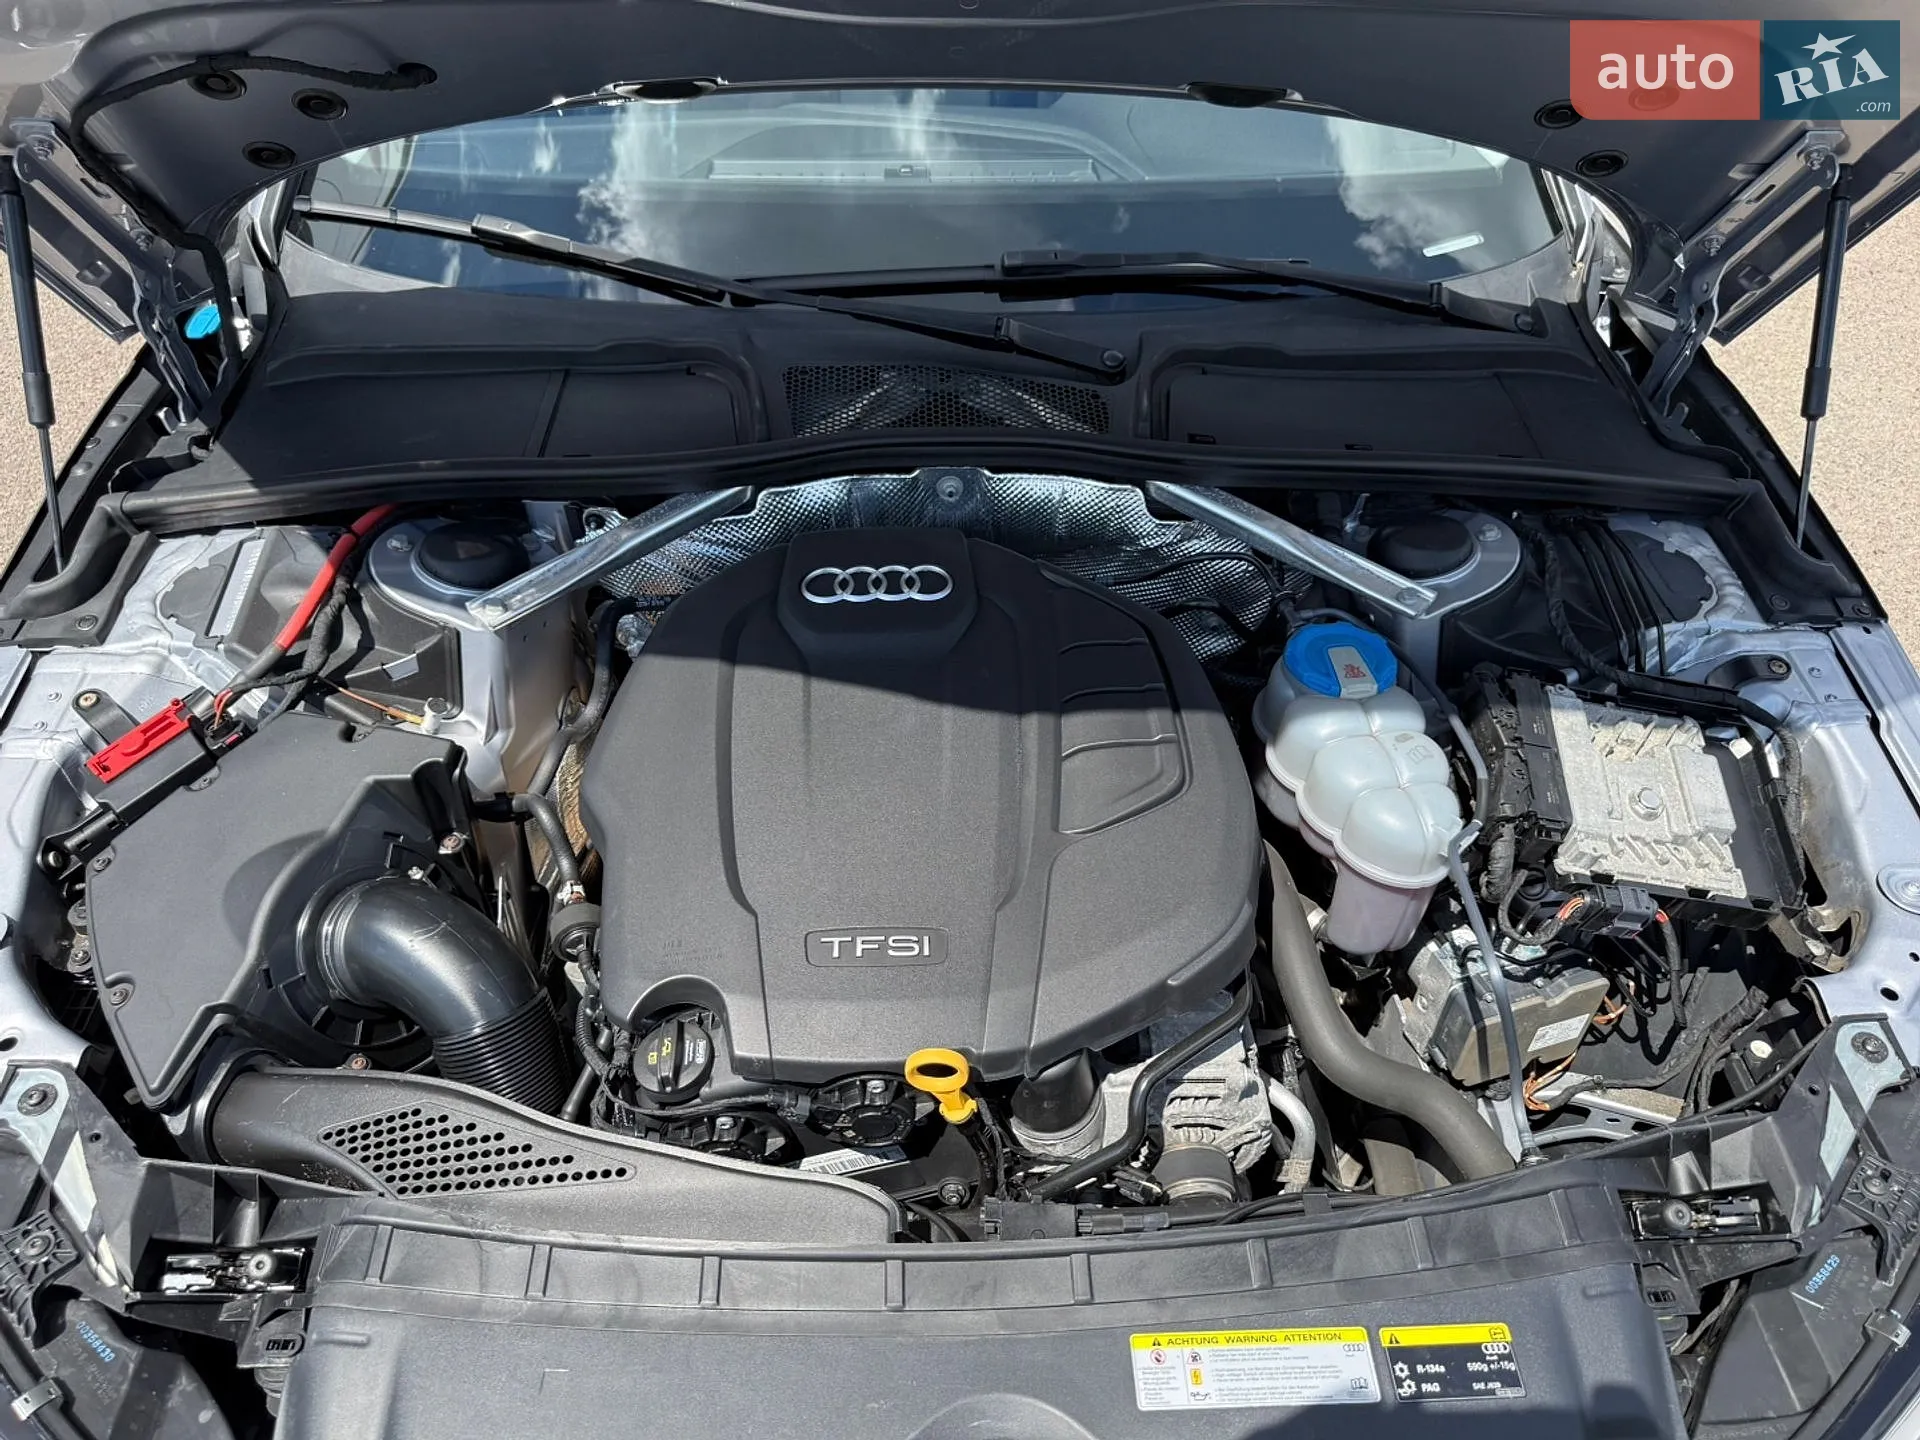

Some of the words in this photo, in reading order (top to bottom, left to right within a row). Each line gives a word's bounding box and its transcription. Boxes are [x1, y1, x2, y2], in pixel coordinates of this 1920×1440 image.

[820, 935, 930, 958] TFSI
[1167, 1336, 1218, 1345] ACHTUNG
[1224, 1334, 1278, 1344] WARNING
[1283, 1332, 1342, 1342] ATTENTION
[1421, 1382, 1441, 1393] PAG
